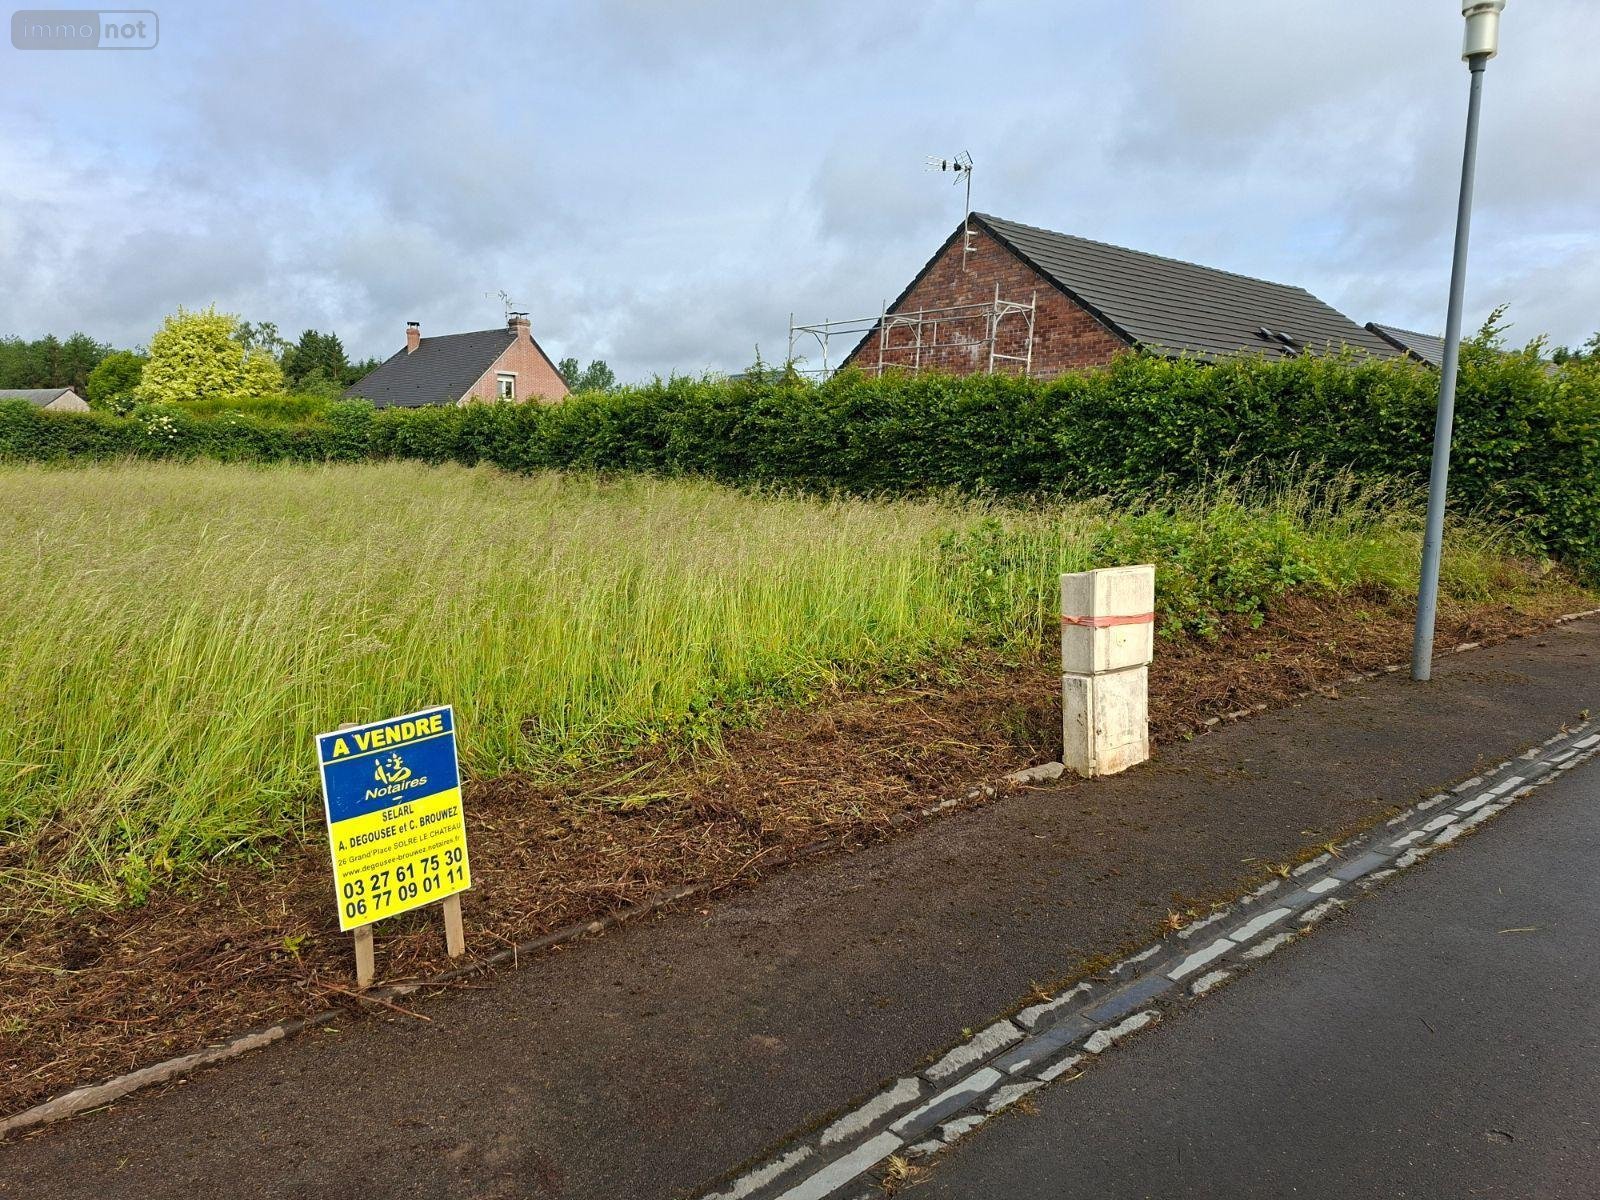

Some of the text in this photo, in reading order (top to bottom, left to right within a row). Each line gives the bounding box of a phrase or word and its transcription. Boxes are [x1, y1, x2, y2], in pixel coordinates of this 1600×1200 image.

[333, 714, 443, 757] A VENDRE
[365, 776, 428, 800] Notaires
[338, 805, 458, 851] A. DEGOUSEE et C. BROUWEZ
[382, 804, 414, 822] SELARL
[338, 858, 347, 867] 26
[393, 837, 418, 851] SOLRE
[420, 833, 427, 842] LE
[343, 847, 463, 899] 03 27 61 75 30
[346, 865, 463, 918] 06 77 09 01 11
